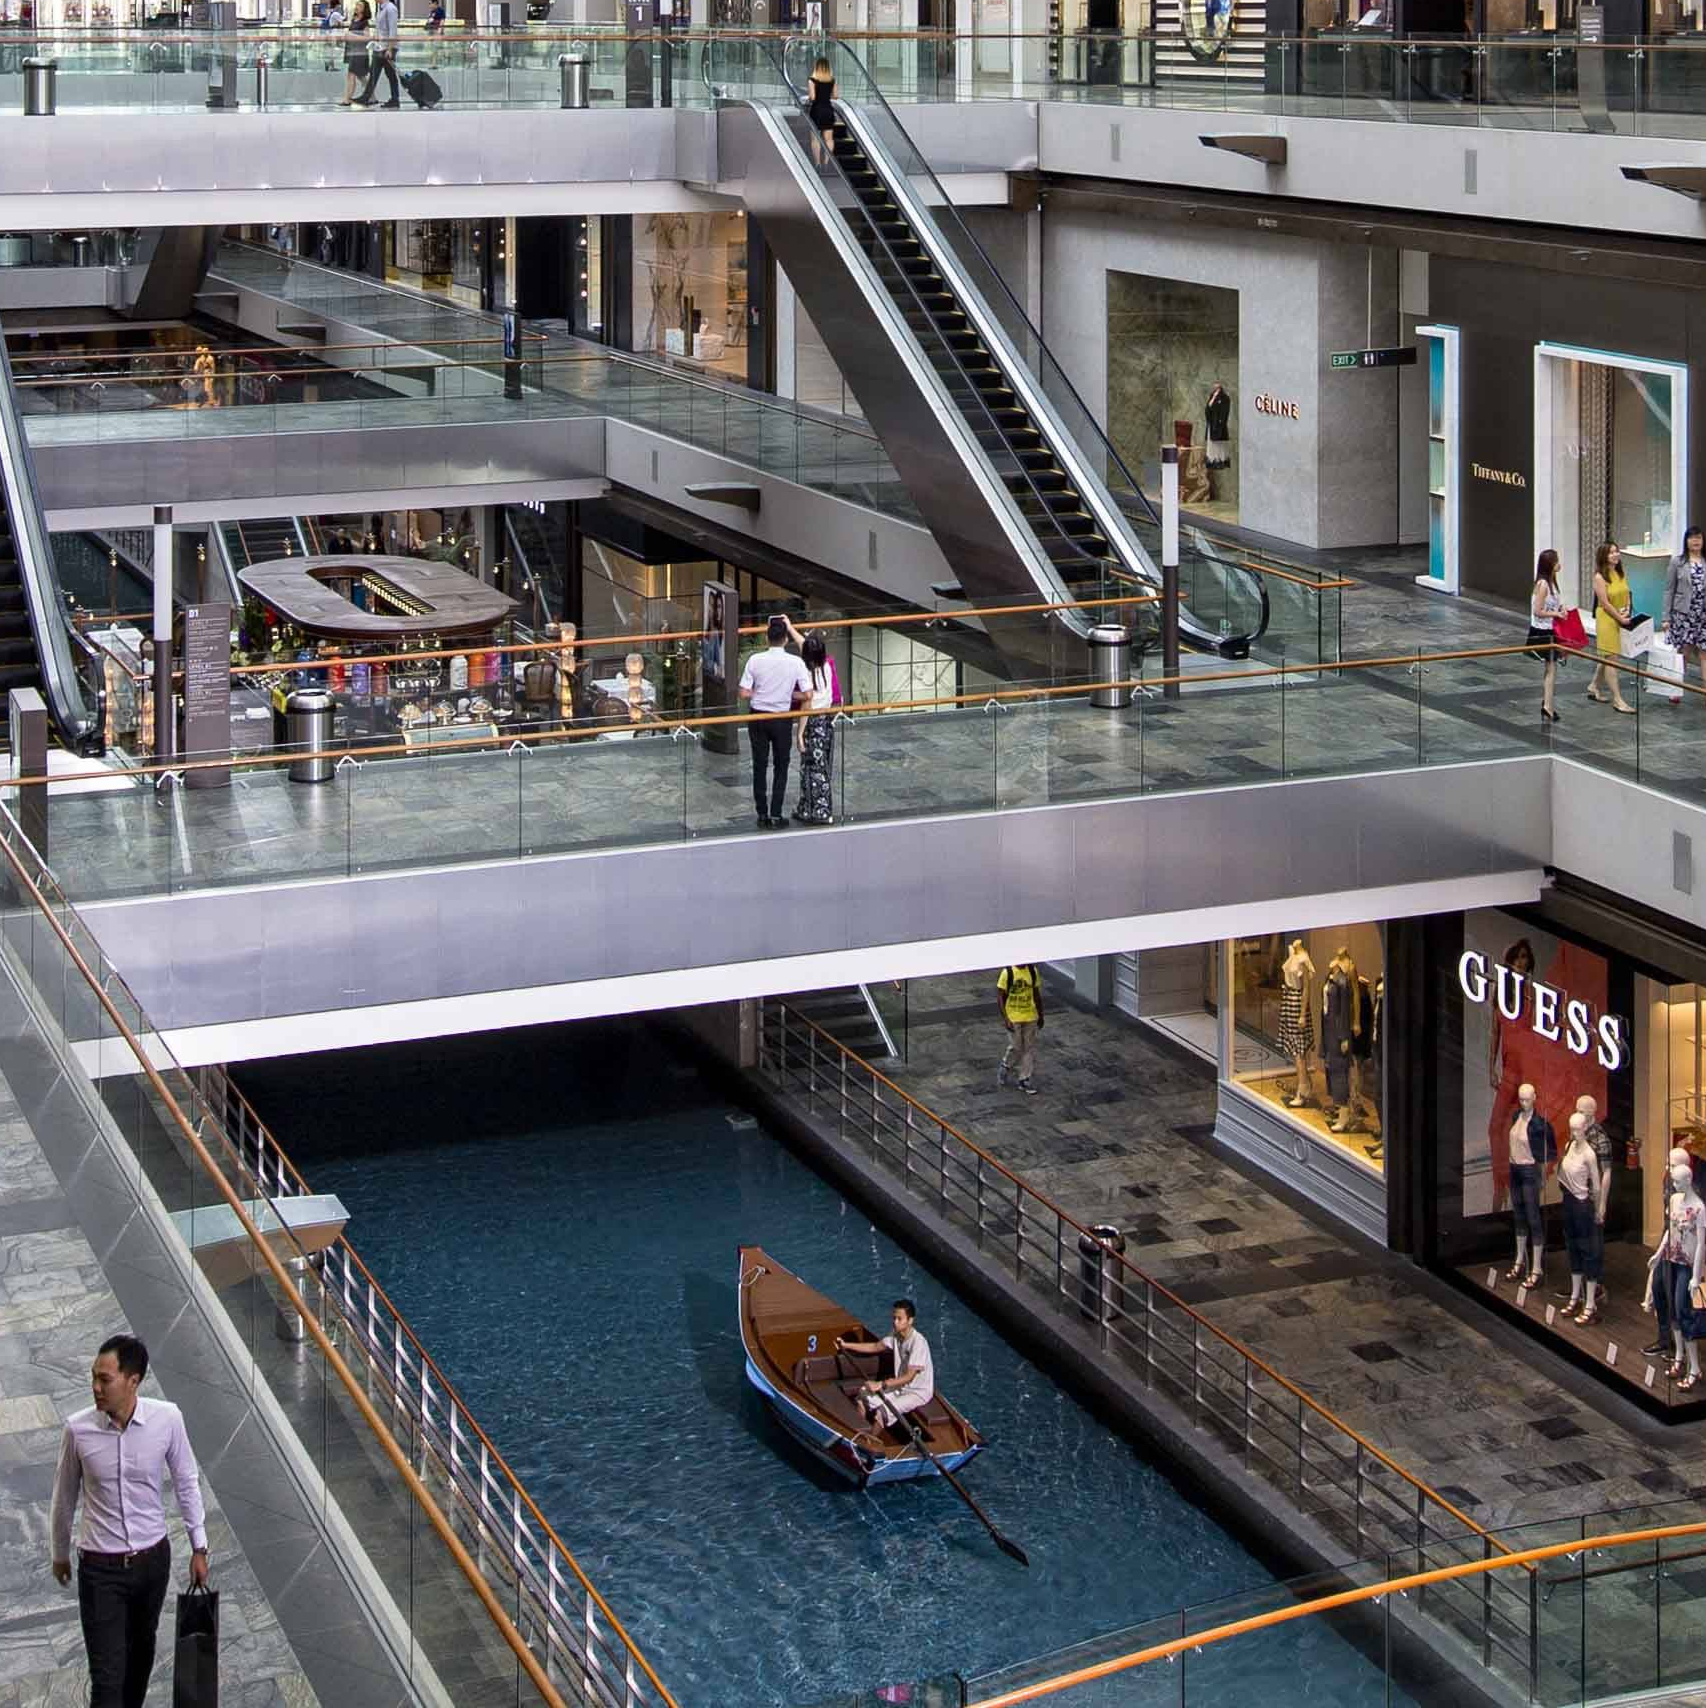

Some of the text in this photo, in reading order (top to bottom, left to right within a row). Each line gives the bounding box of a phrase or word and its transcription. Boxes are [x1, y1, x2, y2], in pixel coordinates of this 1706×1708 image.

[635, 6, 643, 21] 1
[1332, 353, 1350, 366] EXIT
[1458, 951, 1621, 1071] GUESS
[808, 1335, 818, 1352] 3
